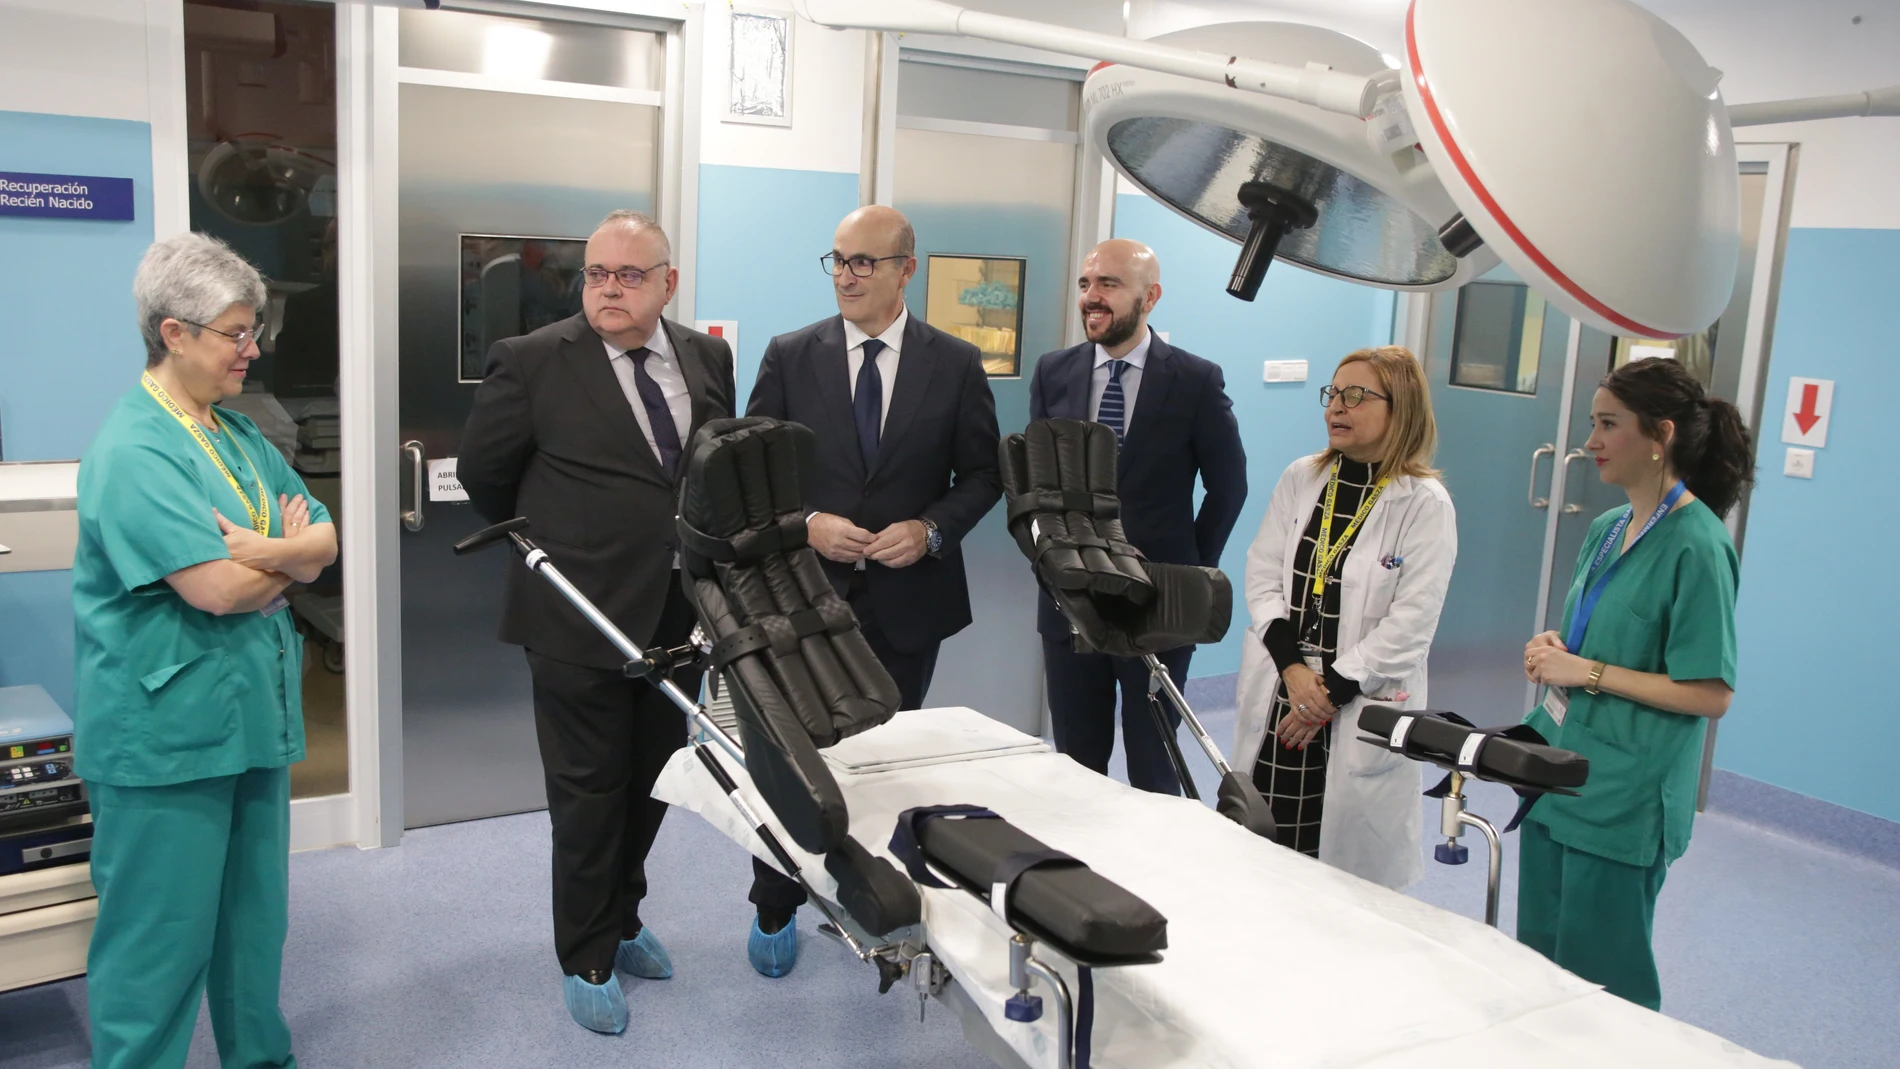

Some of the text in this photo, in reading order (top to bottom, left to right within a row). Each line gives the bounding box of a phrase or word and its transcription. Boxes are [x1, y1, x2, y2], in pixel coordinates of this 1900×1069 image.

[0, 179, 88, 195] Recuperación
[0, 195, 93, 209] Recién Nacido
[190, 423, 210, 448] GASZA
[1368, 485, 1384, 506] GASZA
[1594, 519, 1626, 569] ESPECIALISTA
